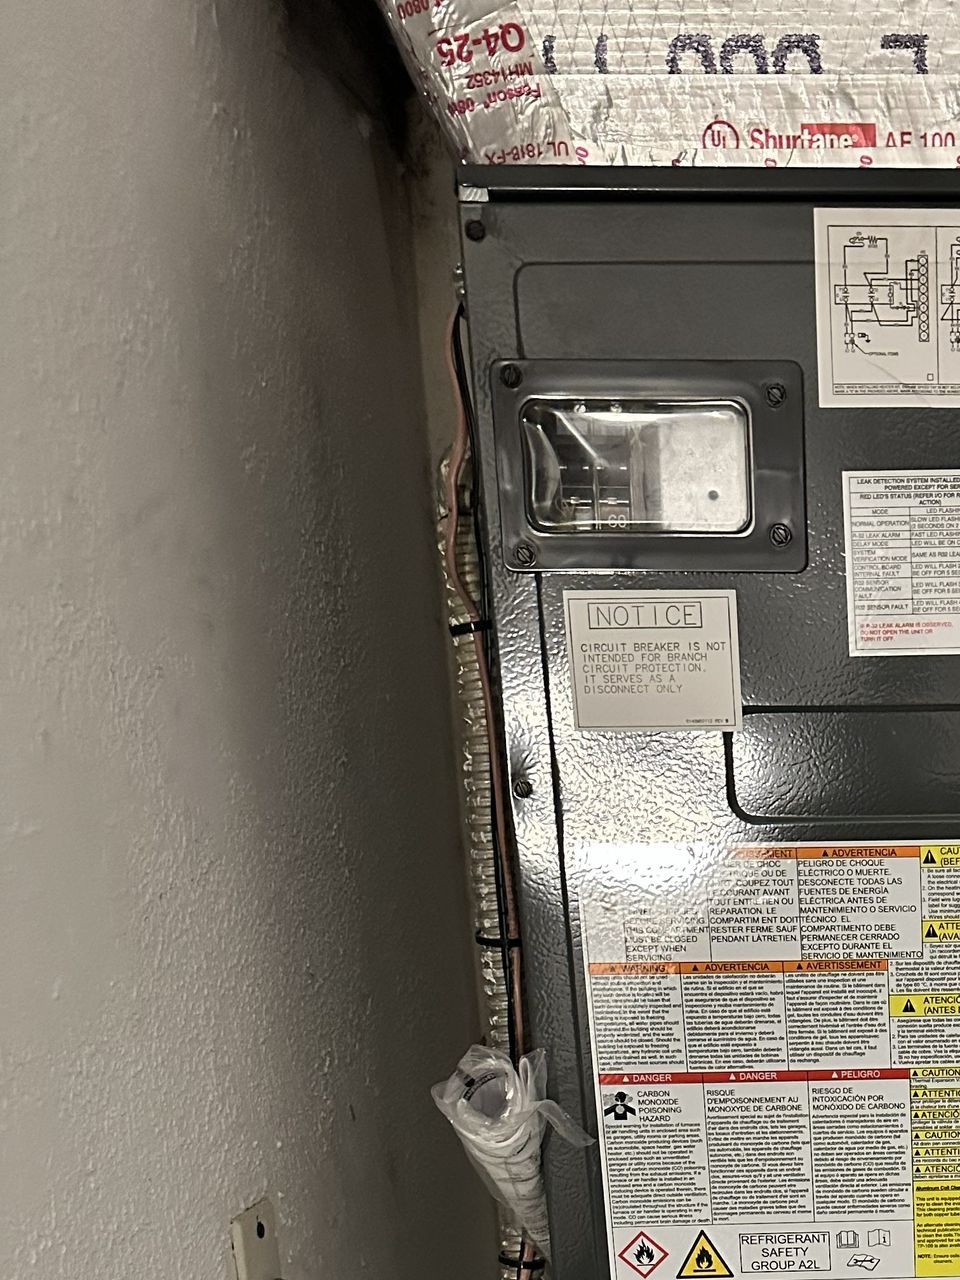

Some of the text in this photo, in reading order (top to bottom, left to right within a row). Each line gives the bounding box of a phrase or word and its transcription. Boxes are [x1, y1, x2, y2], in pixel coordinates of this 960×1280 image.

[436, 22, 525, 67] Q4-25
[596, 605, 696, 626] NOTICE
[581, 642, 726, 653] CIRCUIT BREAKER IS NOT
[583, 653, 708, 663] INTENDED FOR BRANCH
[583, 663, 706, 673] CIRCUIT PROTECTION.
[585, 675, 595, 684] IT
[603, 675, 642, 683] SERVES
[650, 674, 662, 682] AS
[584, 684, 682, 694] DISCONNECT ONLY
[832, 849, 896, 857] ADVERTENCIA
[798, 859, 884, 868] PELIGRO DE CHOQUE
[633, 1074, 672, 1082] DANGER
[841, 1070, 880, 1078] PELIGRO
[922, 1069, 960, 1077] CAUTION
[742, 1234, 827, 1244] REFRIGERANT
[762, 1247, 808, 1258] SAFETY
[752, 1260, 820, 1270] GROUP A2L
